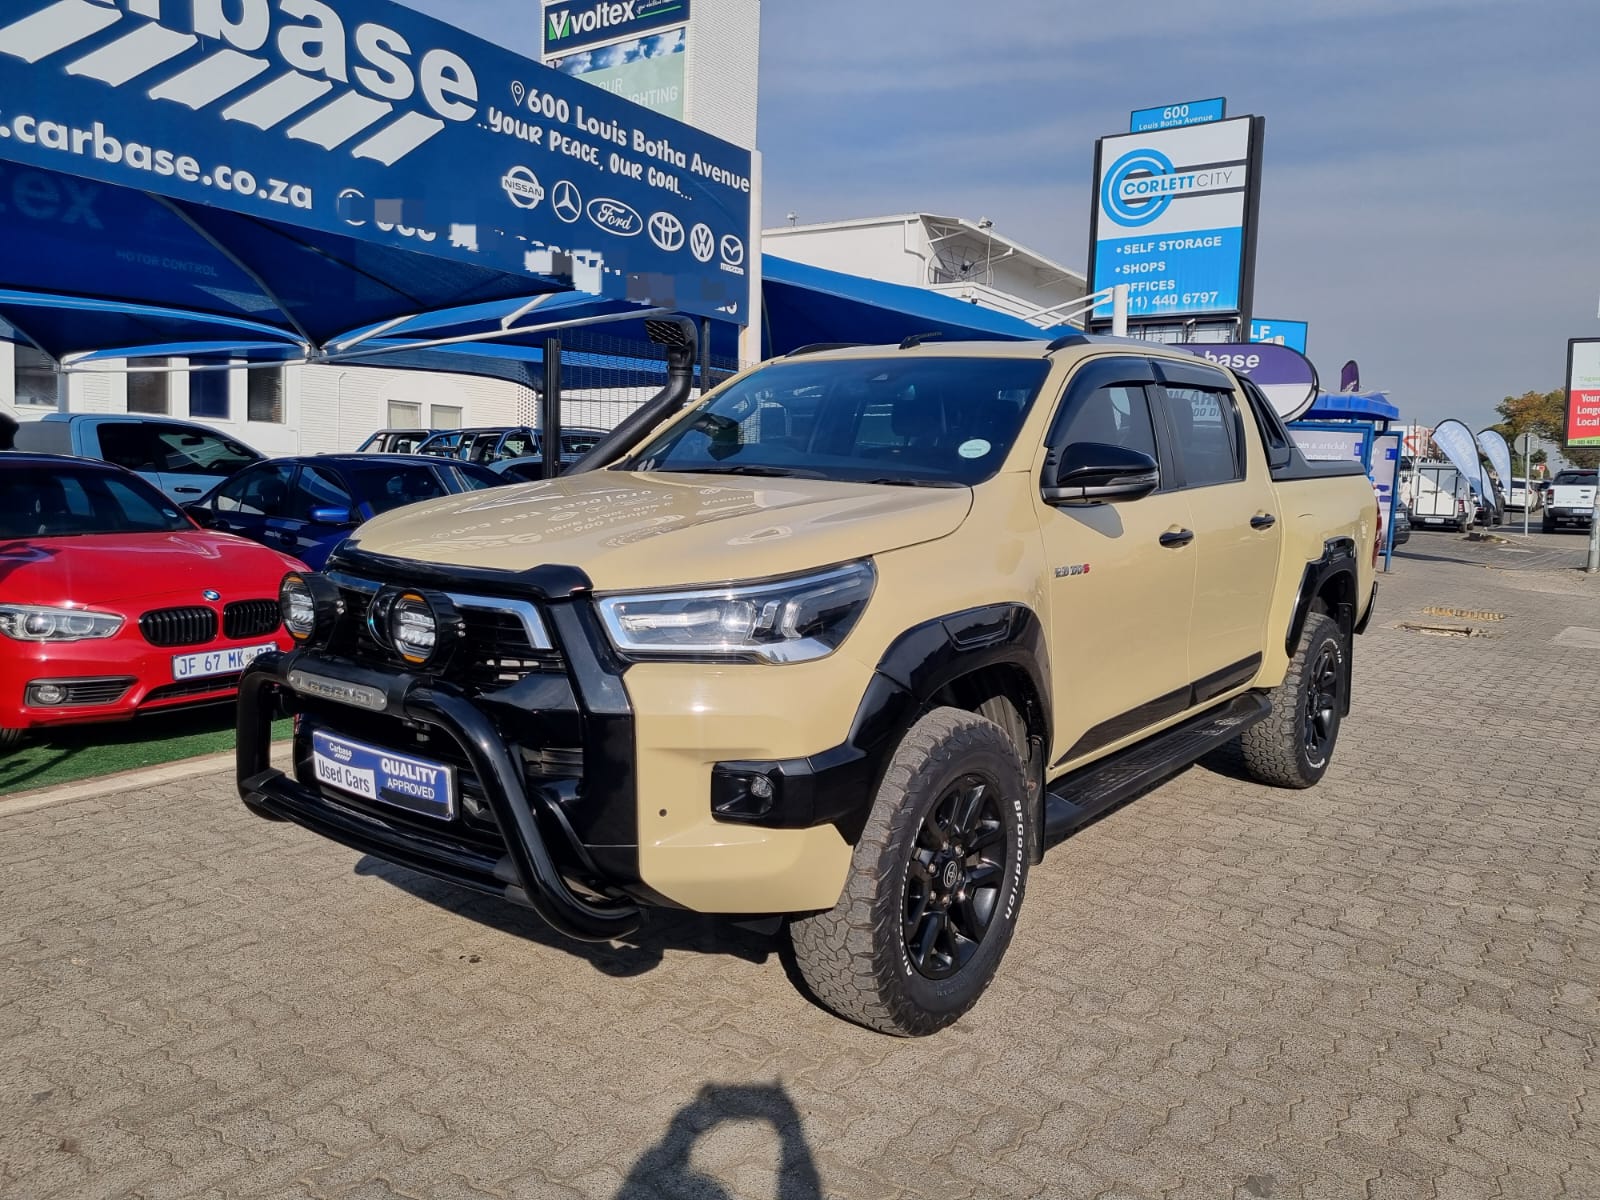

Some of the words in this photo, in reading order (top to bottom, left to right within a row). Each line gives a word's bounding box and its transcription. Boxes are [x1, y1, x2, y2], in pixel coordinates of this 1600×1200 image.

[571, 0, 636, 34] voltex
[1139, 122, 1158, 131] Louis
[1160, 118, 1182, 127] Botha
[1184, 114, 1213, 123] Avenue
[1163, 105, 1189, 119] 600
[527, 89, 569, 123] 600
[577, 106, 627, 146] Louis
[633, 129, 686, 168] Botha
[691, 153, 750, 193] Avenue
[609, 153, 642, 181] OUR
[504, 179, 542, 197] NISSAN
[1123, 175, 1195, 196] CORLETT
[1196, 170, 1233, 187] CITY
[598, 203, 633, 230] Ford
[1123, 242, 1155, 255] SELF
[1158, 236, 1222, 251] STORAGE
[1122, 261, 1166, 274] SHOPS
[1151, 294, 1178, 305] 440
[1182, 291, 1218, 304] 6797
[180, 657, 196, 675] JF
[205, 654, 221, 671] 67
[228, 651, 244, 669] MK
[329, 742, 352, 757] Carbase
[318, 759, 343, 783] Used
[345, 771, 370, 793] Cars
[381, 758, 437, 785] QUALITY
[387, 777, 435, 800] APPROVED
